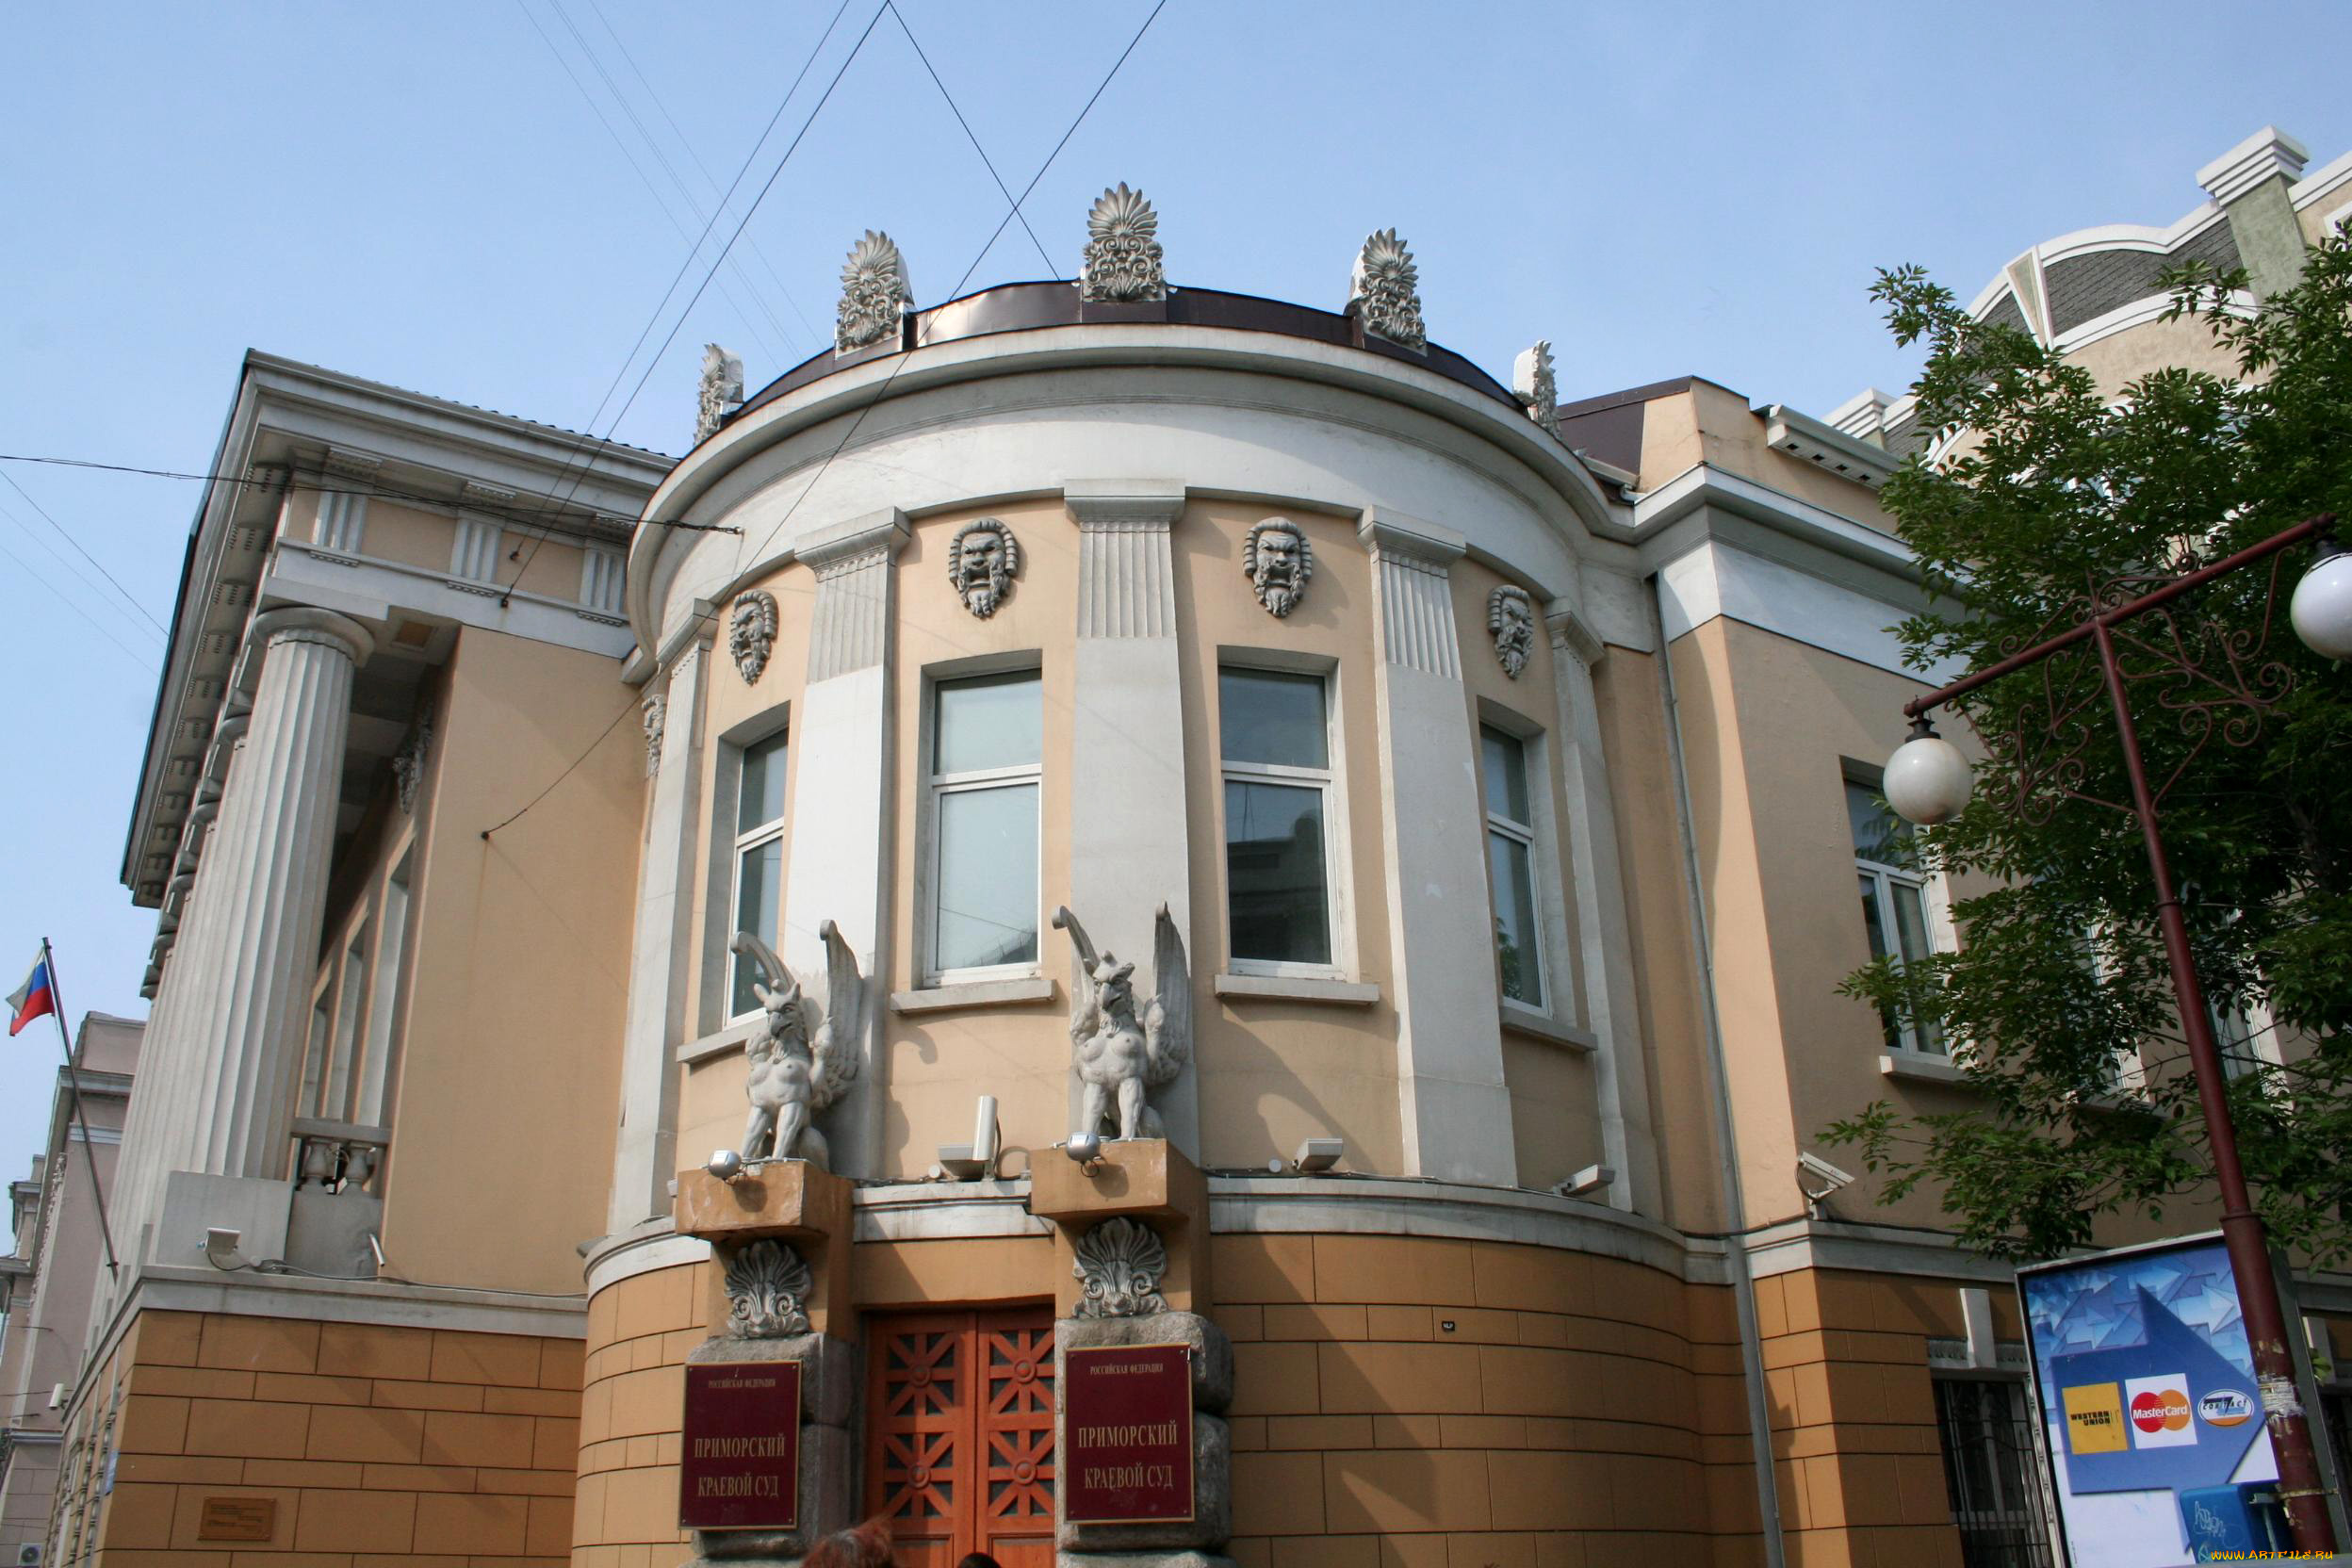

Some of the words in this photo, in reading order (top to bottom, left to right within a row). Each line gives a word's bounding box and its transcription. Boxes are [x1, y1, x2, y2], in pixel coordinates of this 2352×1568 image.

[2070, 1410, 2110, 1420] WESTERN
[2083, 1417, 2111, 1426] UNION
[2132, 1403, 2188, 1419] MasterCard
[694, 1432, 785, 1458] ПРИМОРСКИЙ
[1078, 1419, 1177, 1448] ПРИМОРСКИЙ
[697, 1471, 753, 1497] КРАЕВОЙ
[755, 1475, 779, 1498] СУД
[1085, 1462, 1144, 1489] КРАЕВОЙ
[1147, 1464, 1174, 1491] СУД
